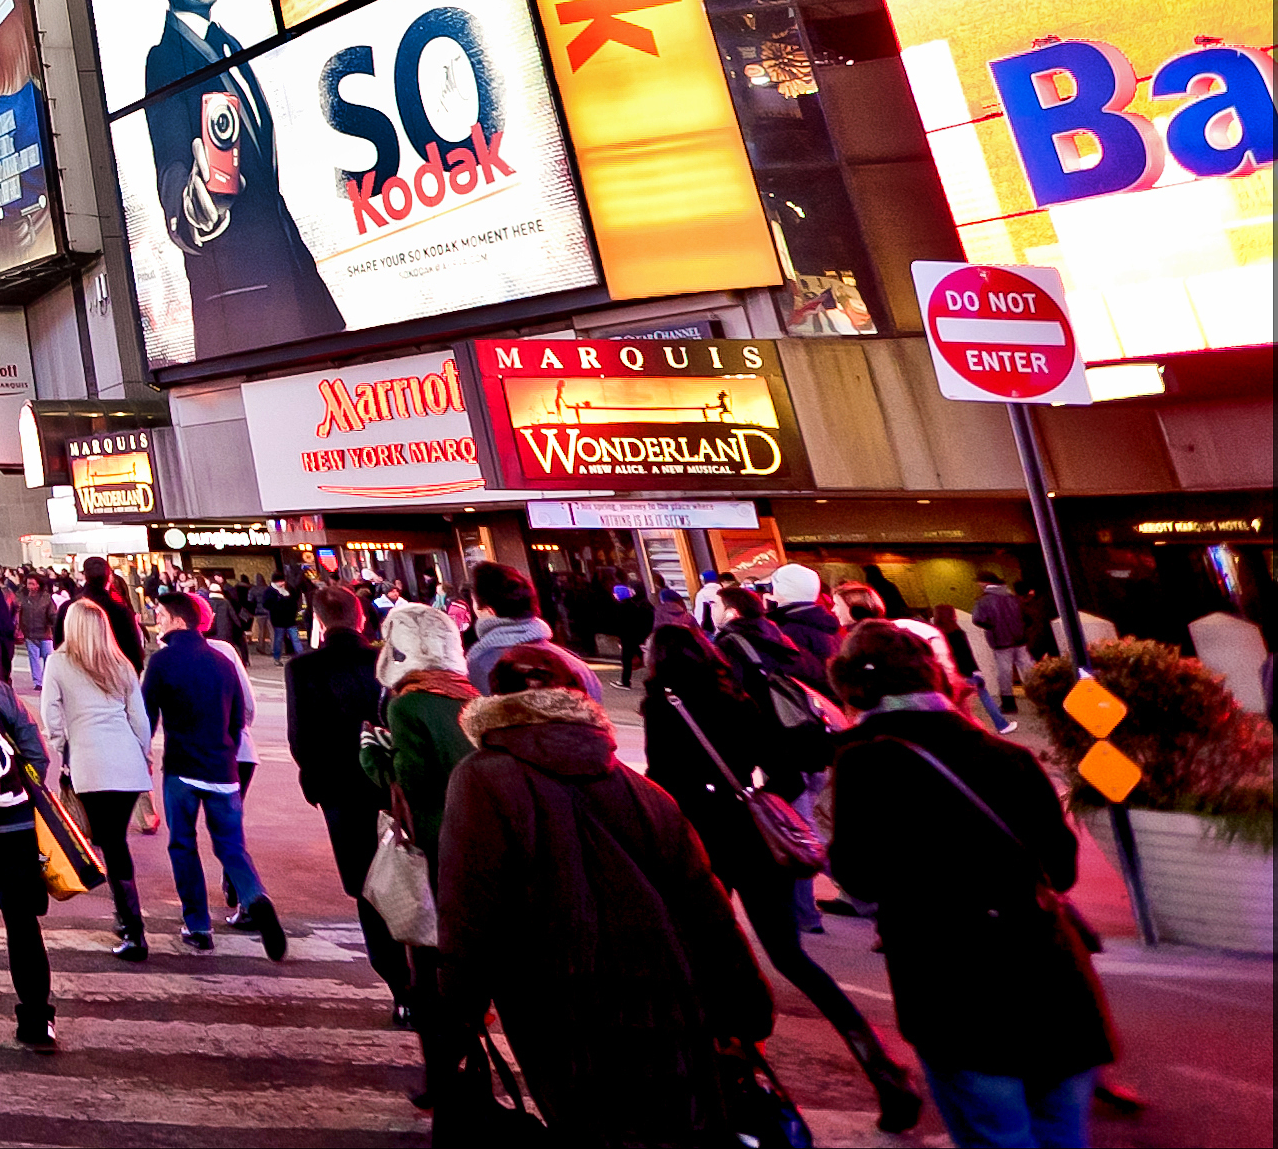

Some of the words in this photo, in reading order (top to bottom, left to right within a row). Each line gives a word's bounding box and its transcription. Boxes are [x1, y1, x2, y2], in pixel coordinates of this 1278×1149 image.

[318, 6, 507, 198] SO
[988, 39, 1273, 211] Ba
[345, 124, 517, 237] Kodak
[347, 260, 379, 278] SHARE
[380, 252, 407, 268] YOUR
[408, 249, 422, 264] SO
[423, 241, 459, 260] KODAK
[460, 227, 509, 248] MOMENT
[511, 218, 545, 238] HERE
[944, 289, 981, 311] DO
[988, 291, 1037, 315] NOT
[494, 345, 764, 371] MARQUIS
[967, 348, 1049, 375] ENTER
[69, 431, 149, 457] MARQUIS
[301, 449, 345, 473] NEW
[347, 443, 409, 469] YORK
[407, 436, 479, 465] MARQ
[519, 427, 782, 476] WONDERLAND
[578, 465, 588, 475] A
[589, 465, 612, 475] NEW
[614, 465, 648, 475] ALICE.
[651, 465, 661, 475] A
[662, 465, 685, 475] NEW
[687, 465, 736, 475] MUSICAL.
[76, 483, 155, 515] WONDERLAND
[600, 514, 632, 526] NOTHING
[633, 514, 641, 526] IS
[644, 514, 653, 526] AS
[654, 514, 663, 526] IT
[186, 526, 251, 550] sunglass
